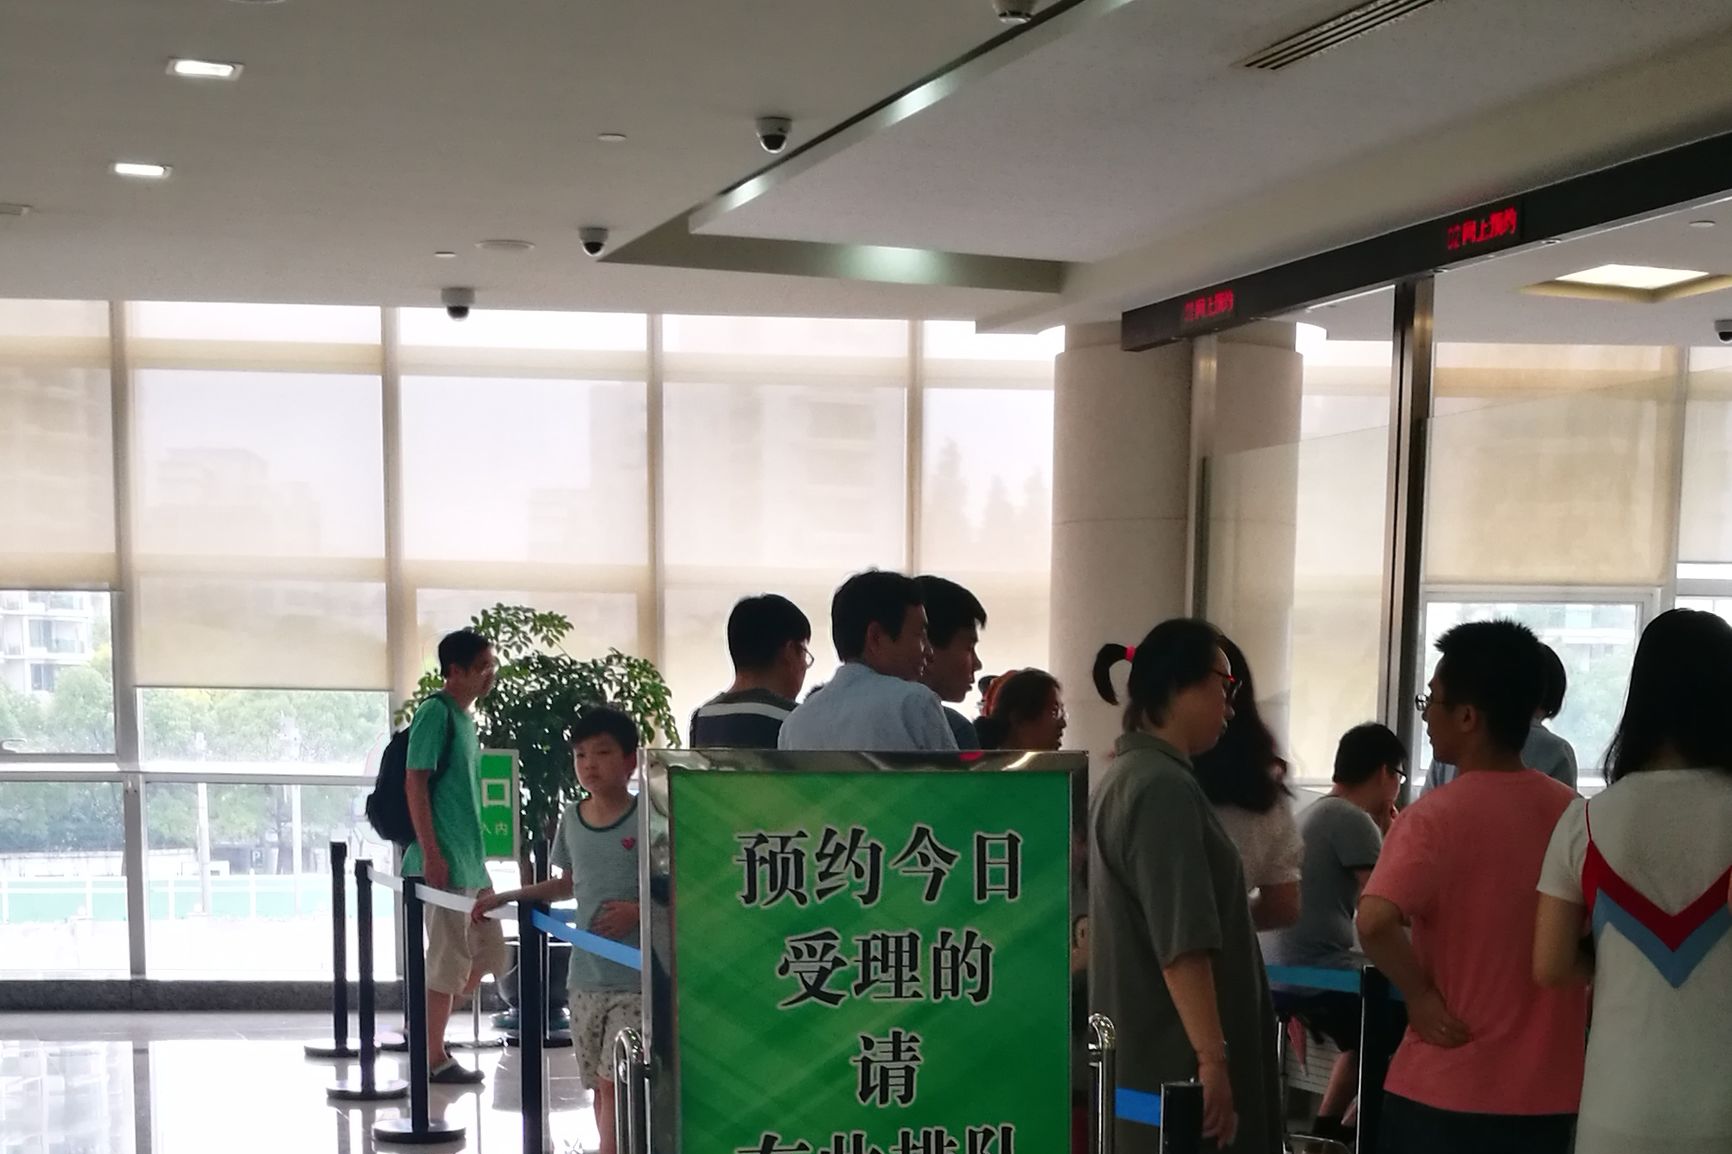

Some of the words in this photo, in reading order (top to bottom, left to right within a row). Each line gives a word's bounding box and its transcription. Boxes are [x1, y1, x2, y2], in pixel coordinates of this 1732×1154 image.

[735, 825, 1024, 907] 预约今日
[777, 928, 996, 1008] 受理的
[851, 1029, 923, 1107] 请
